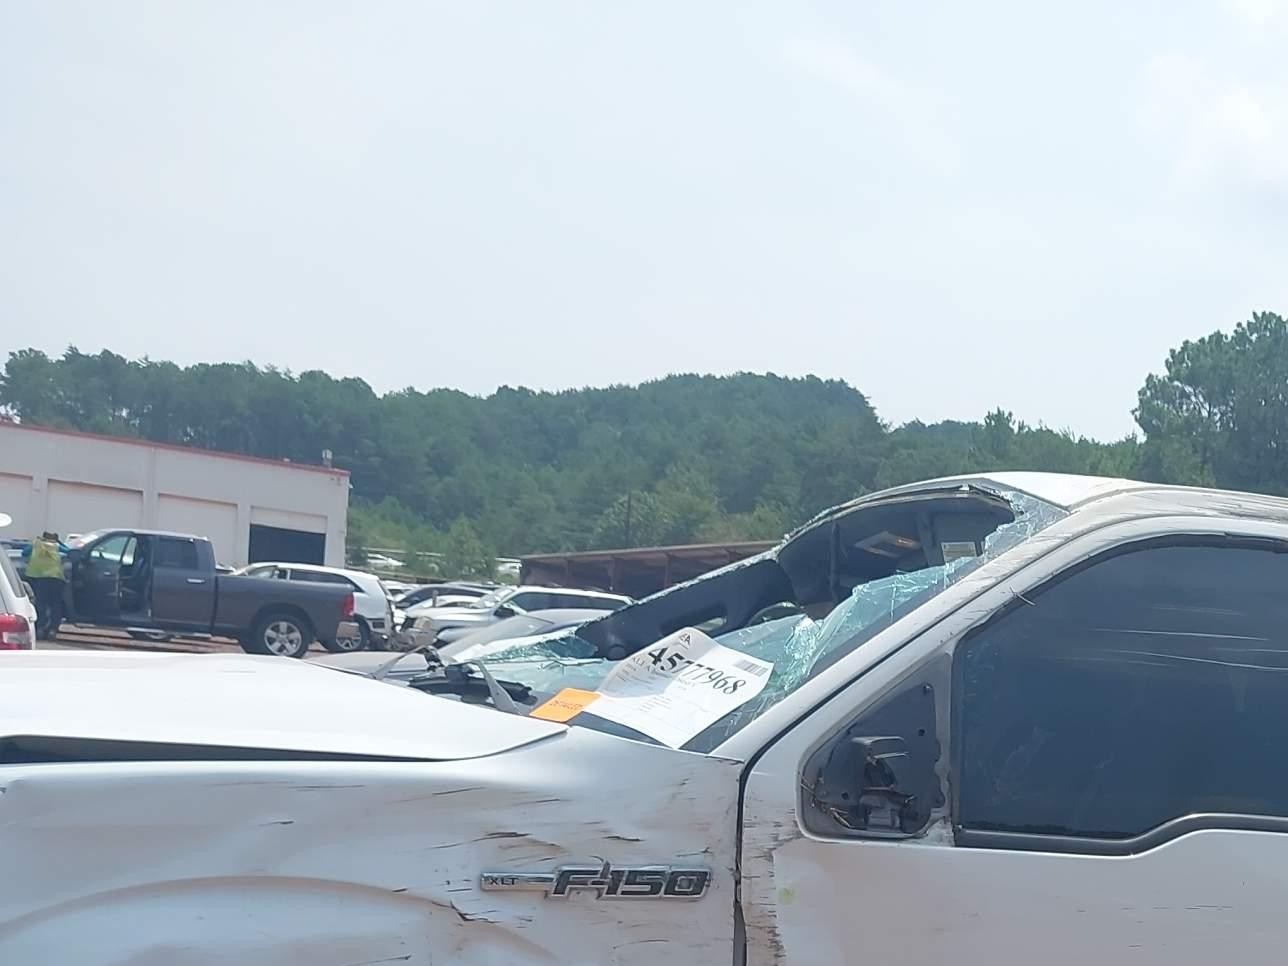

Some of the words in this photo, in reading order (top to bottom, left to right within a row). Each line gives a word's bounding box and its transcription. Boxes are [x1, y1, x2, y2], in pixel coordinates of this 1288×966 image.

[648, 647, 746, 695] 45777968
[489, 876, 519, 887] XLT
[549, 865, 711, 900] F-150
